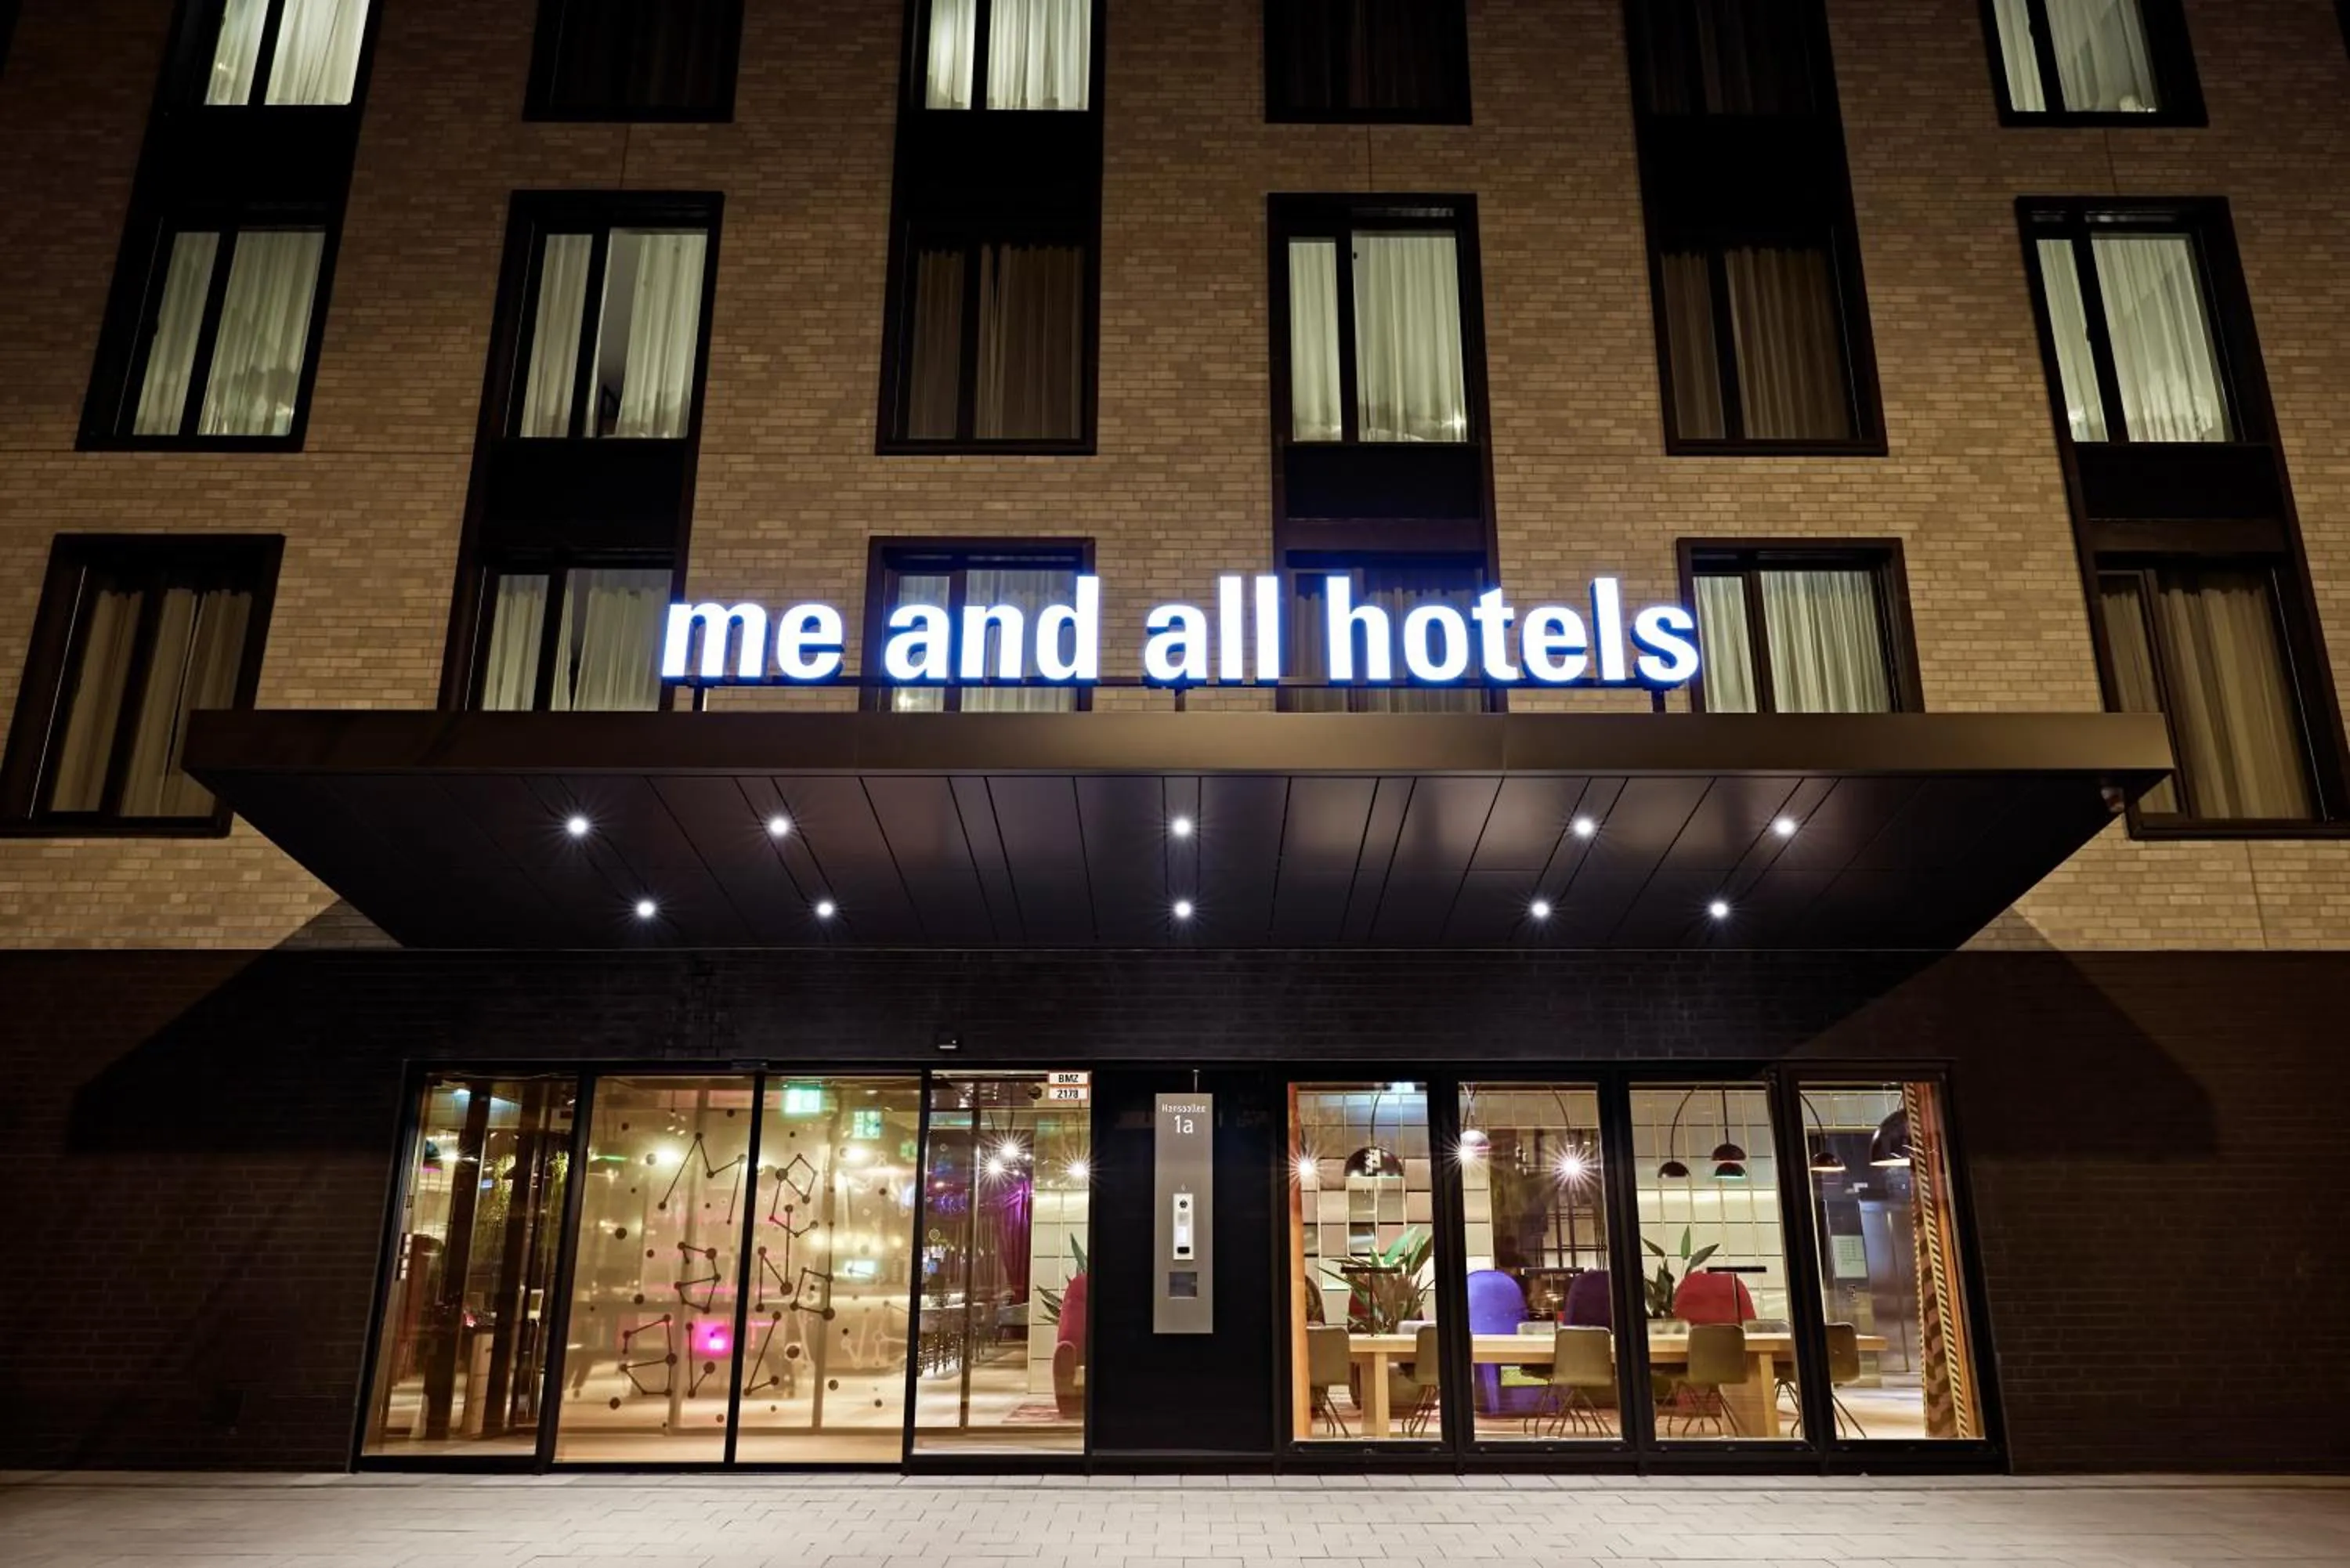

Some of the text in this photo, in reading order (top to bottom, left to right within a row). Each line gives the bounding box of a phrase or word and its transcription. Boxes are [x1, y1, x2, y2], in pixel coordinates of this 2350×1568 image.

[661, 575, 1699, 682] me and all hotels
[1058, 1074, 1079, 1082] BMZ
[1174, 1115, 1194, 1133] 1a
